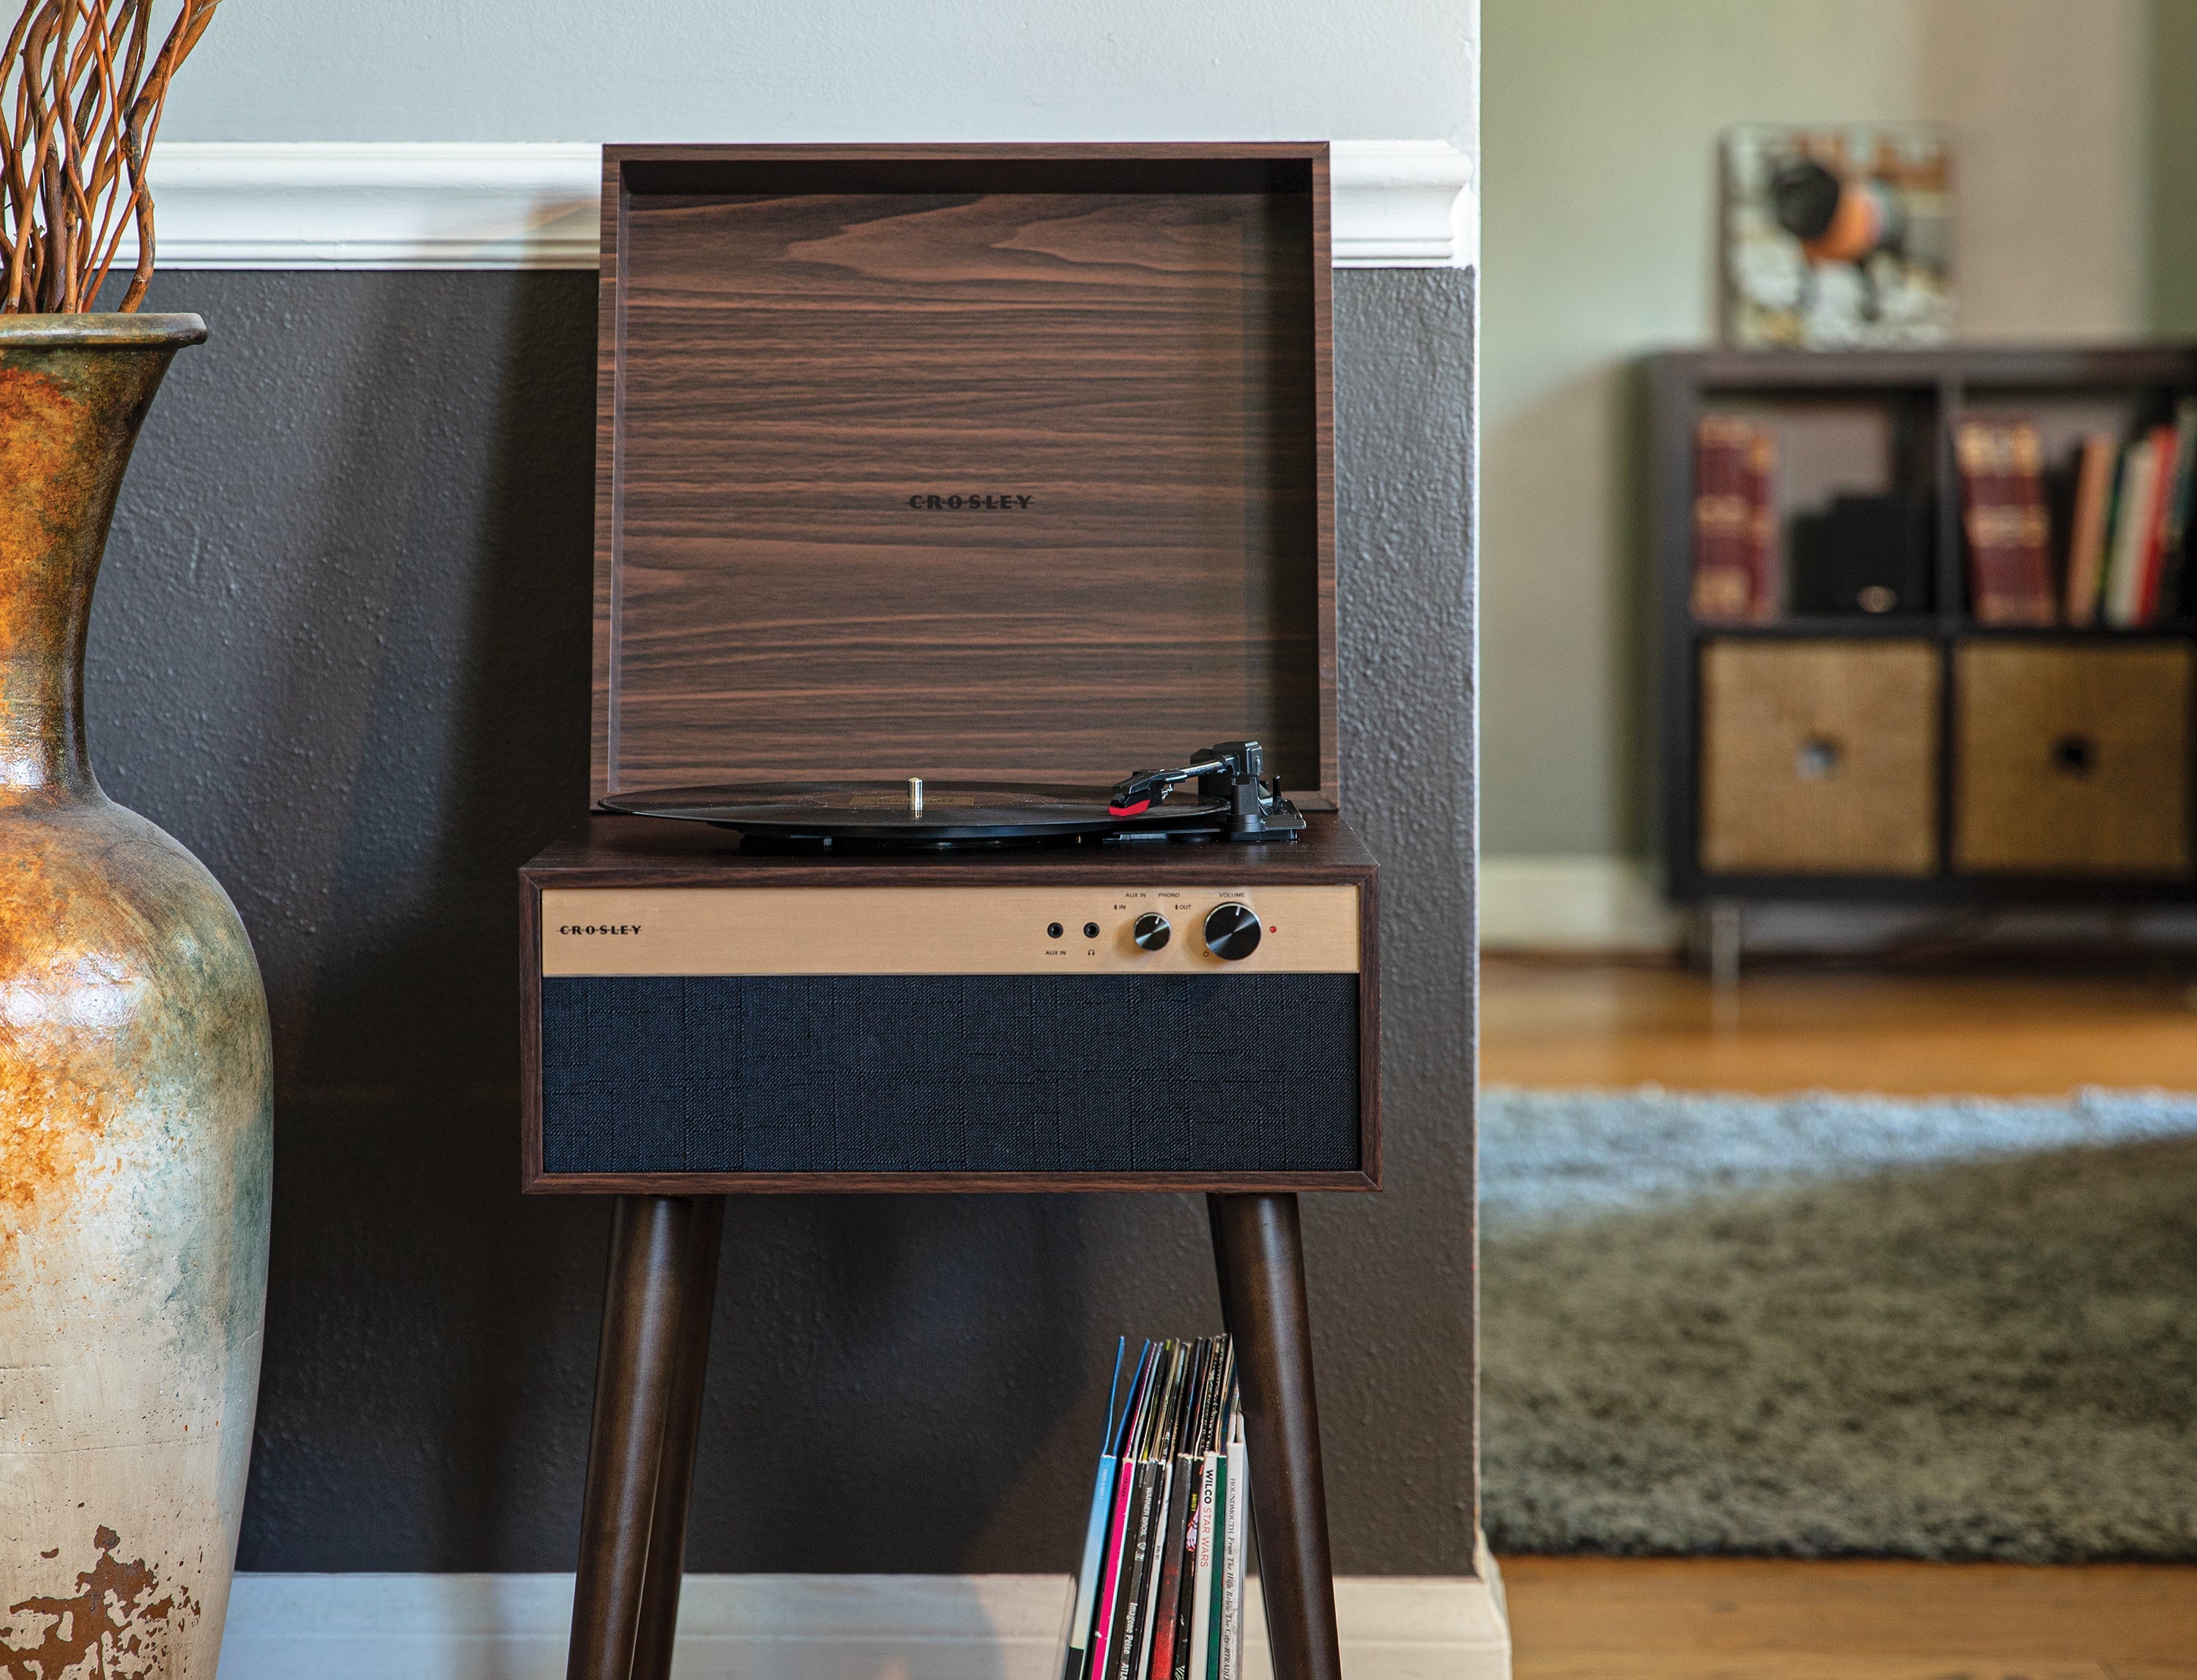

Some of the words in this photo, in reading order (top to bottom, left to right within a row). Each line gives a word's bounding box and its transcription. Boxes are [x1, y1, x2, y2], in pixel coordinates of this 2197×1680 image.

[907, 494, 1033, 510] CROSLEY
[558, 925, 642, 934] CROSLEY
[1204, 1469, 1213, 1504] WILCO
[1143, 1487, 1153, 1515] WARNER
[1228, 1478, 1236, 1534] HOUNDMOUTH
[1140, 1516, 1148, 1536] BROS.
[1202, 1507, 1211, 1534] STAR
[1200, 1536, 1210, 1567] WARS
[1226, 1572, 1234, 1588] Hills
[1126, 1602, 1138, 1633] Imagene
[1123, 1634, 1134, 1654] Peise
